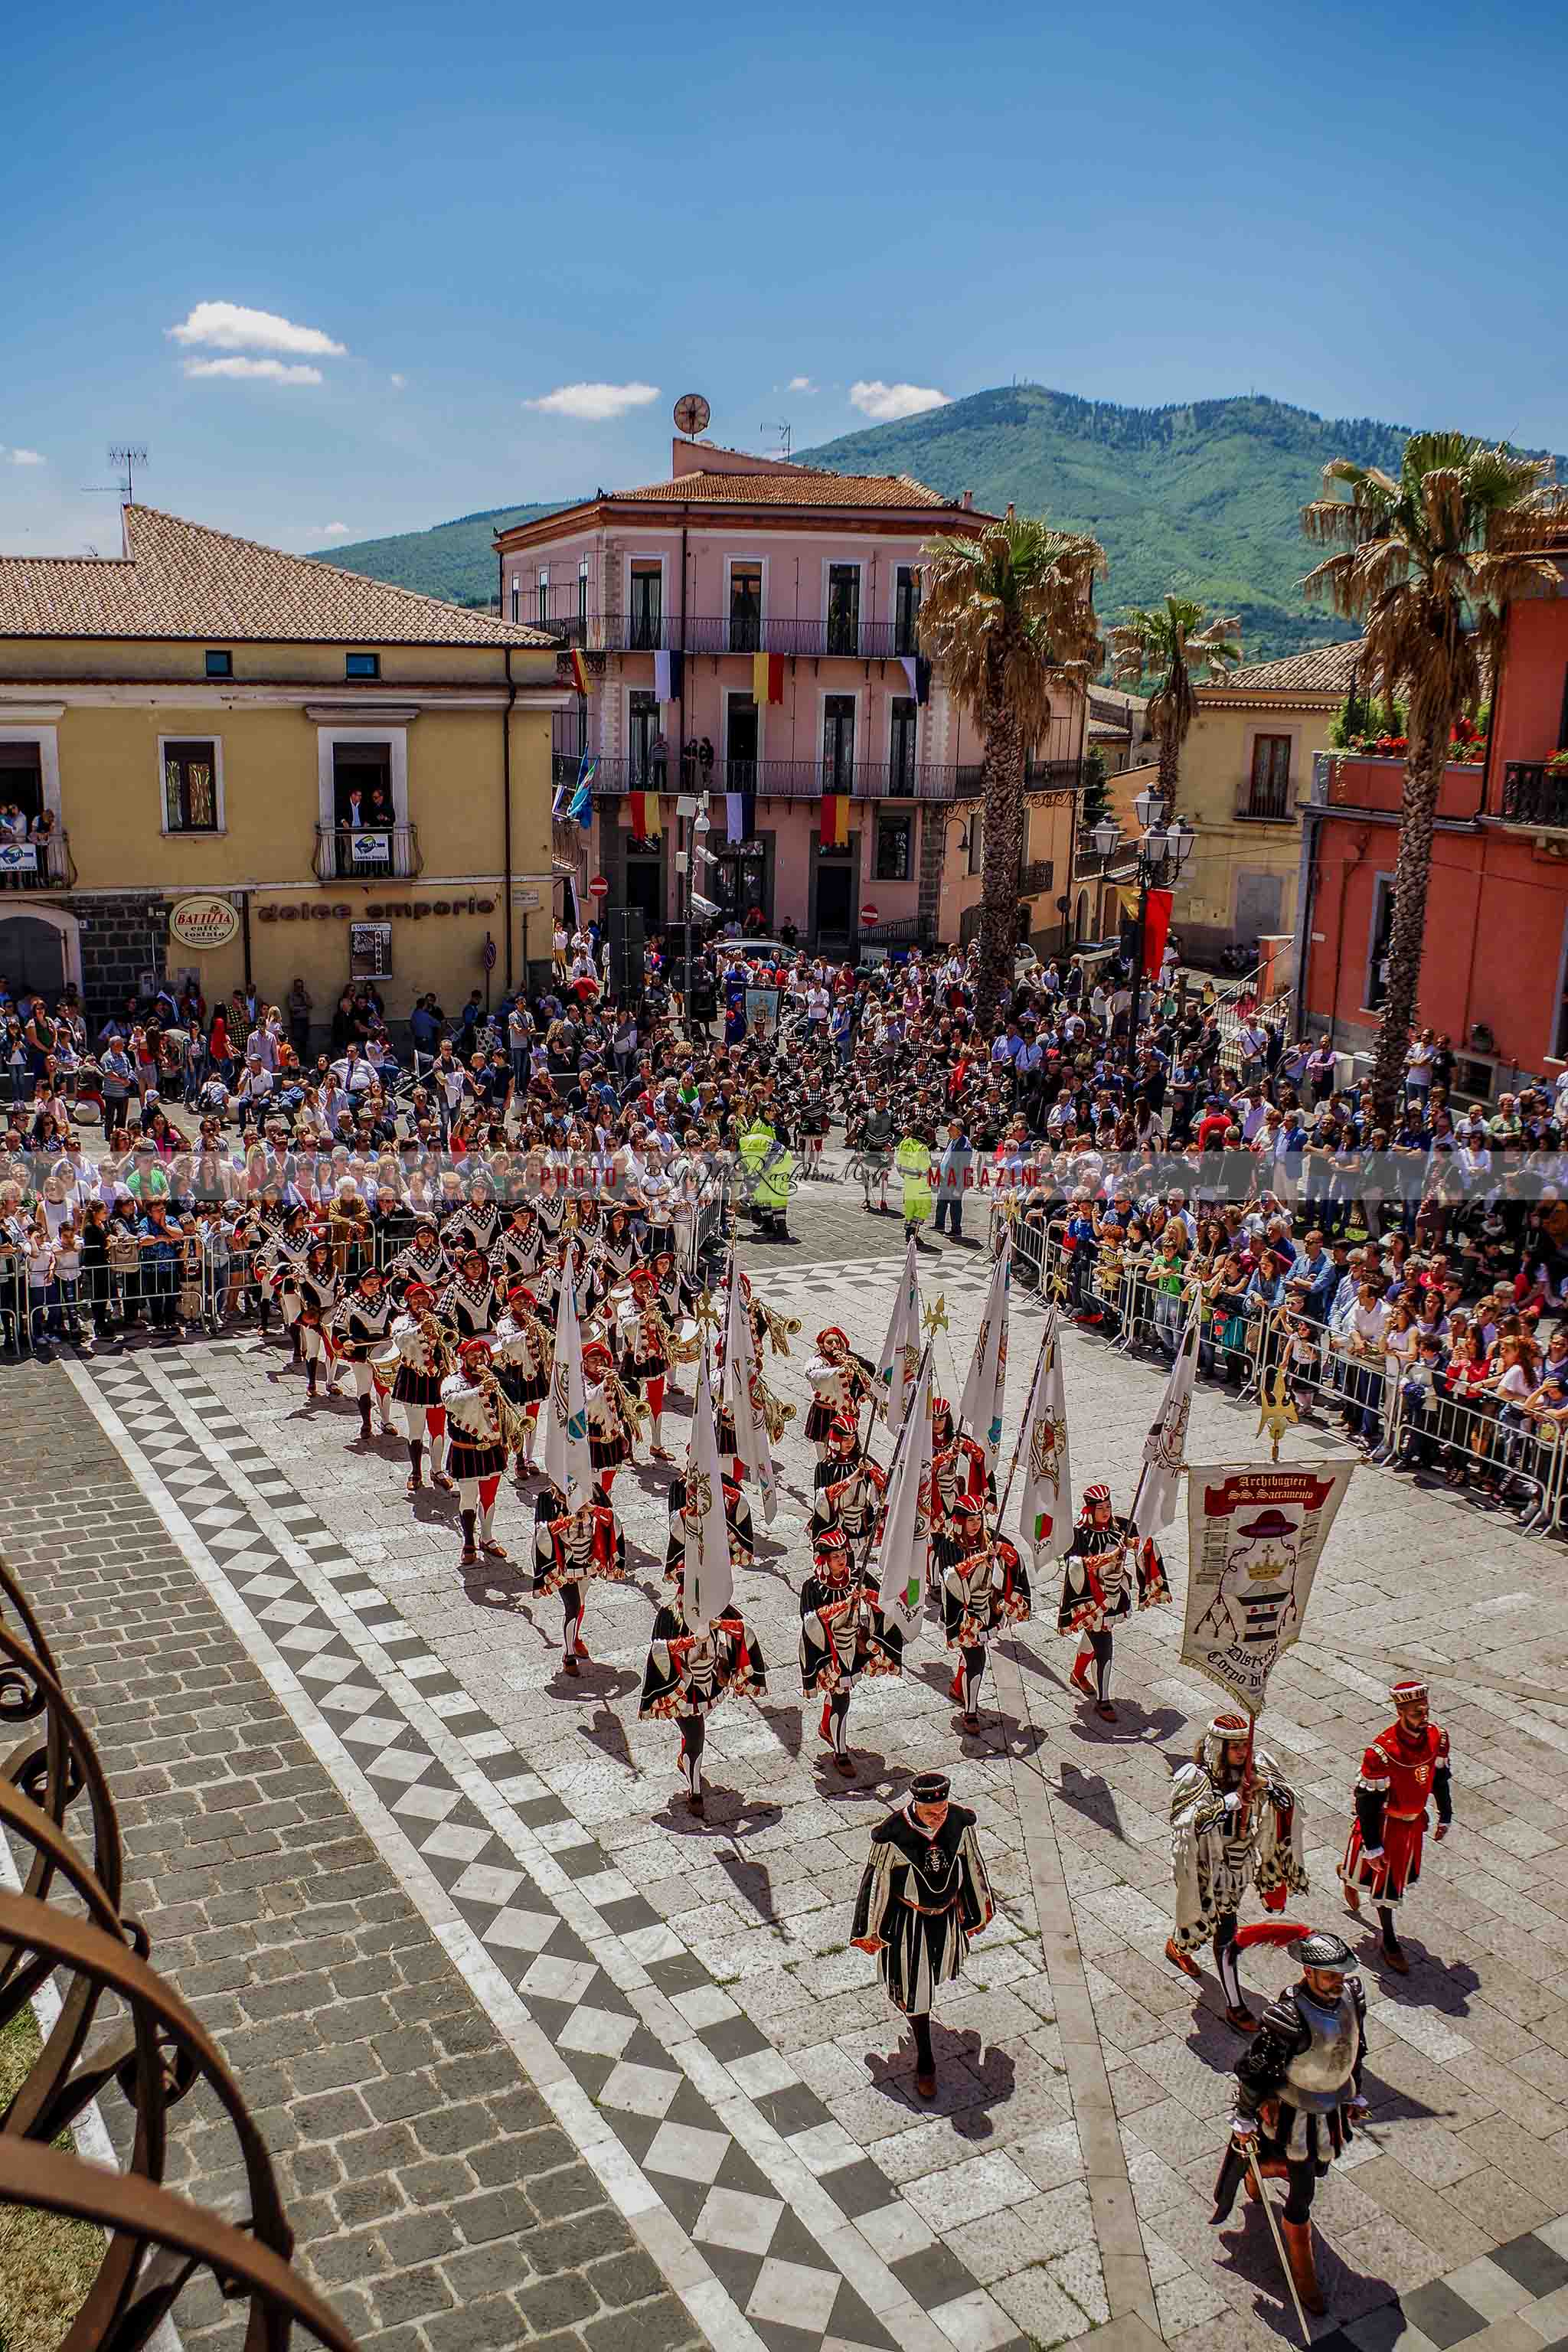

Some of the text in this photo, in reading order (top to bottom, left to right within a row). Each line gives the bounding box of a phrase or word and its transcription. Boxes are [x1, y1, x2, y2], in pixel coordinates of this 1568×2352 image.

[177, 912, 231, 924] BATTISTA
[257, 898, 495, 923] dolce emporio
[1238, 1475, 1308, 1488] Archibugieri
[1207, 1651, 1247, 1685] Corpo
